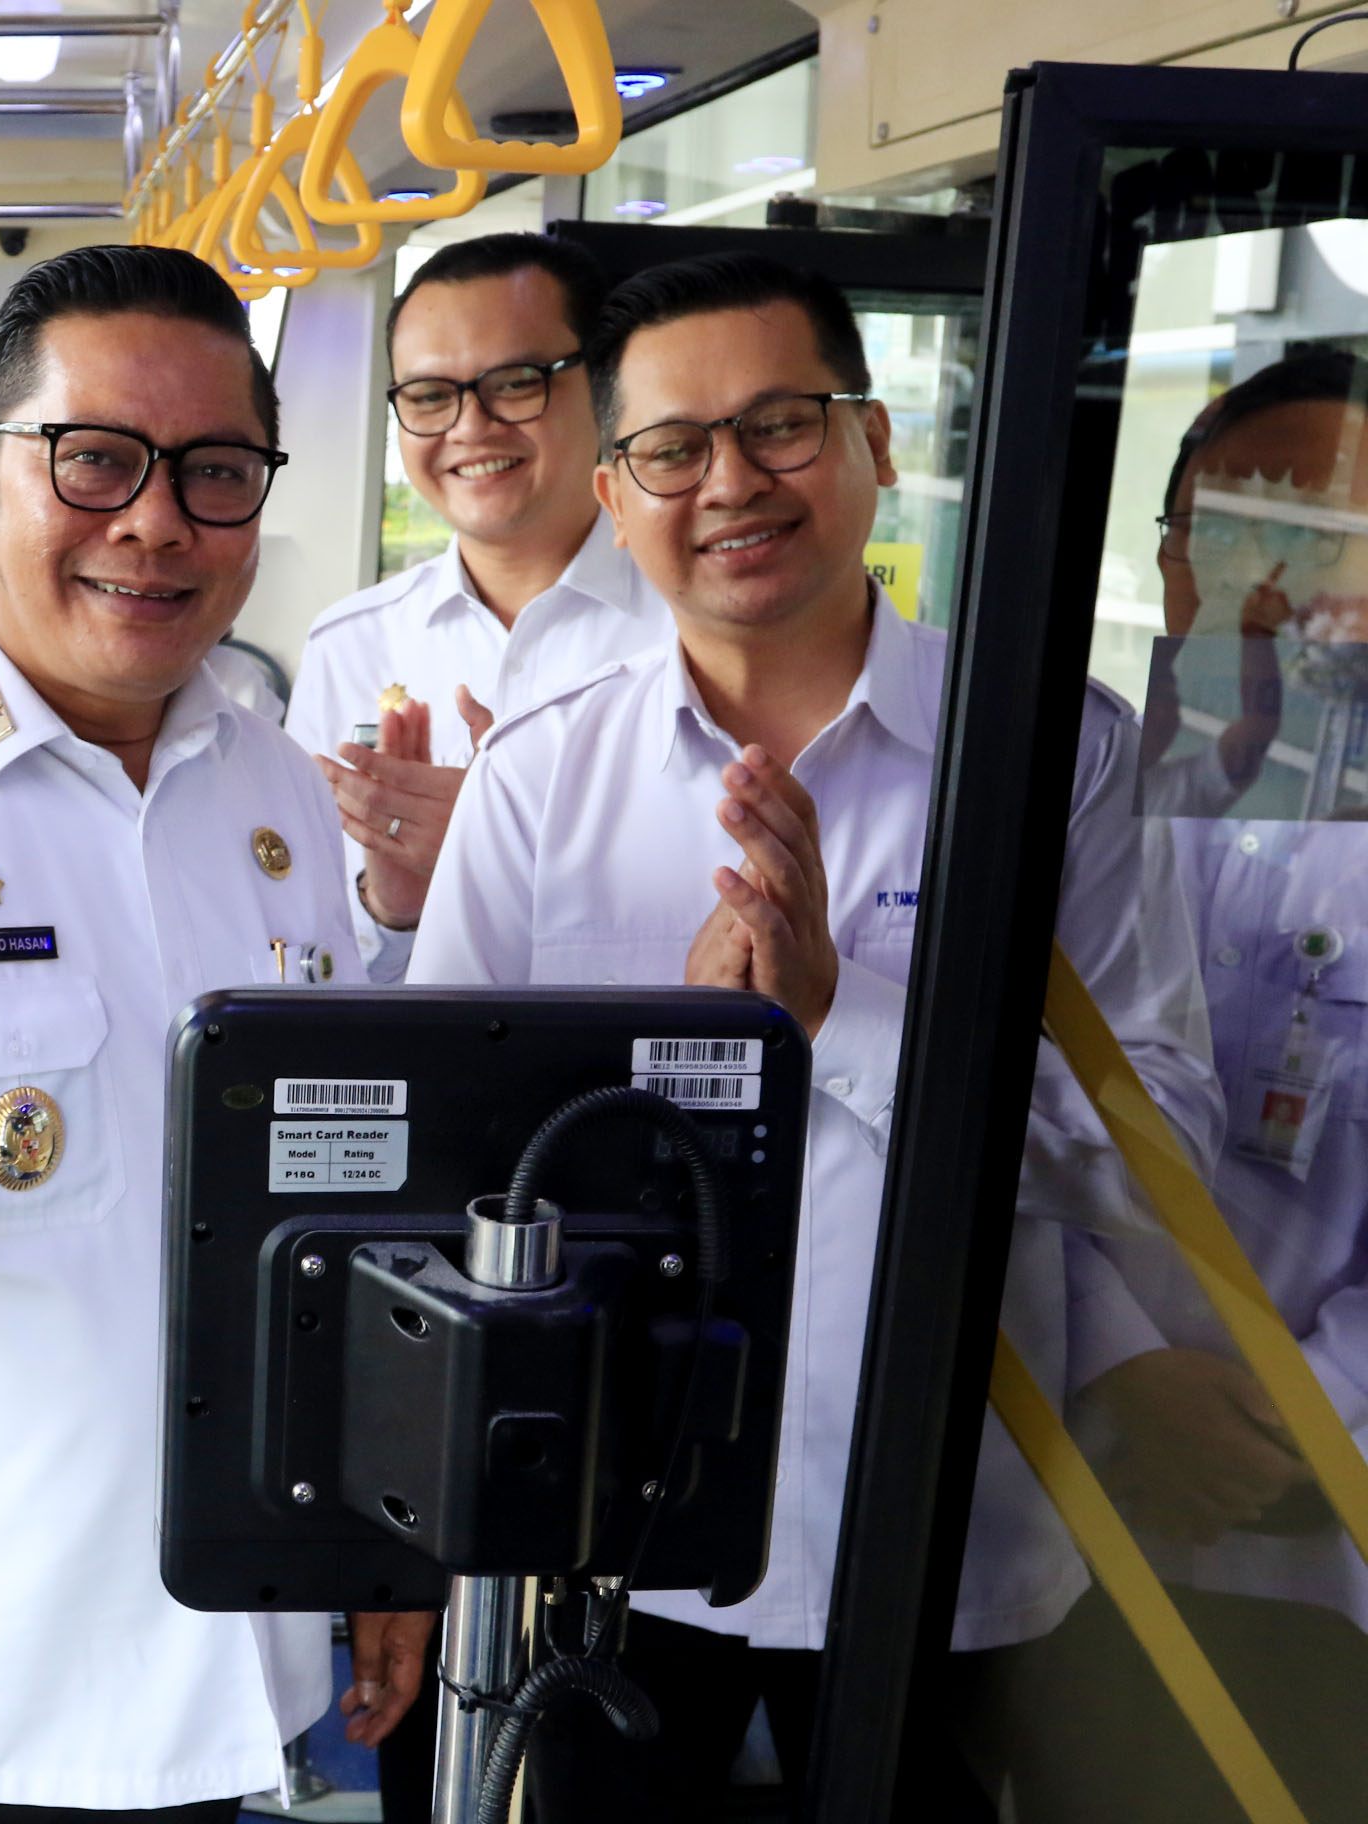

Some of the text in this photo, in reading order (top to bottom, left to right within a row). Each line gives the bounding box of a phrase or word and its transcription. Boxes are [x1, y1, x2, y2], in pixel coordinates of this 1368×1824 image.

[864, 564, 896, 586] RI
[9, 936, 48, 951] HASAN
[277, 1130, 389, 1140] Smart Card Reader
[288, 1150, 317, 1159] Model
[344, 1150, 375, 1160] Rating
[285, 1170, 315, 1179] P18Q
[342, 1170, 381, 1179] 12/24 DC
